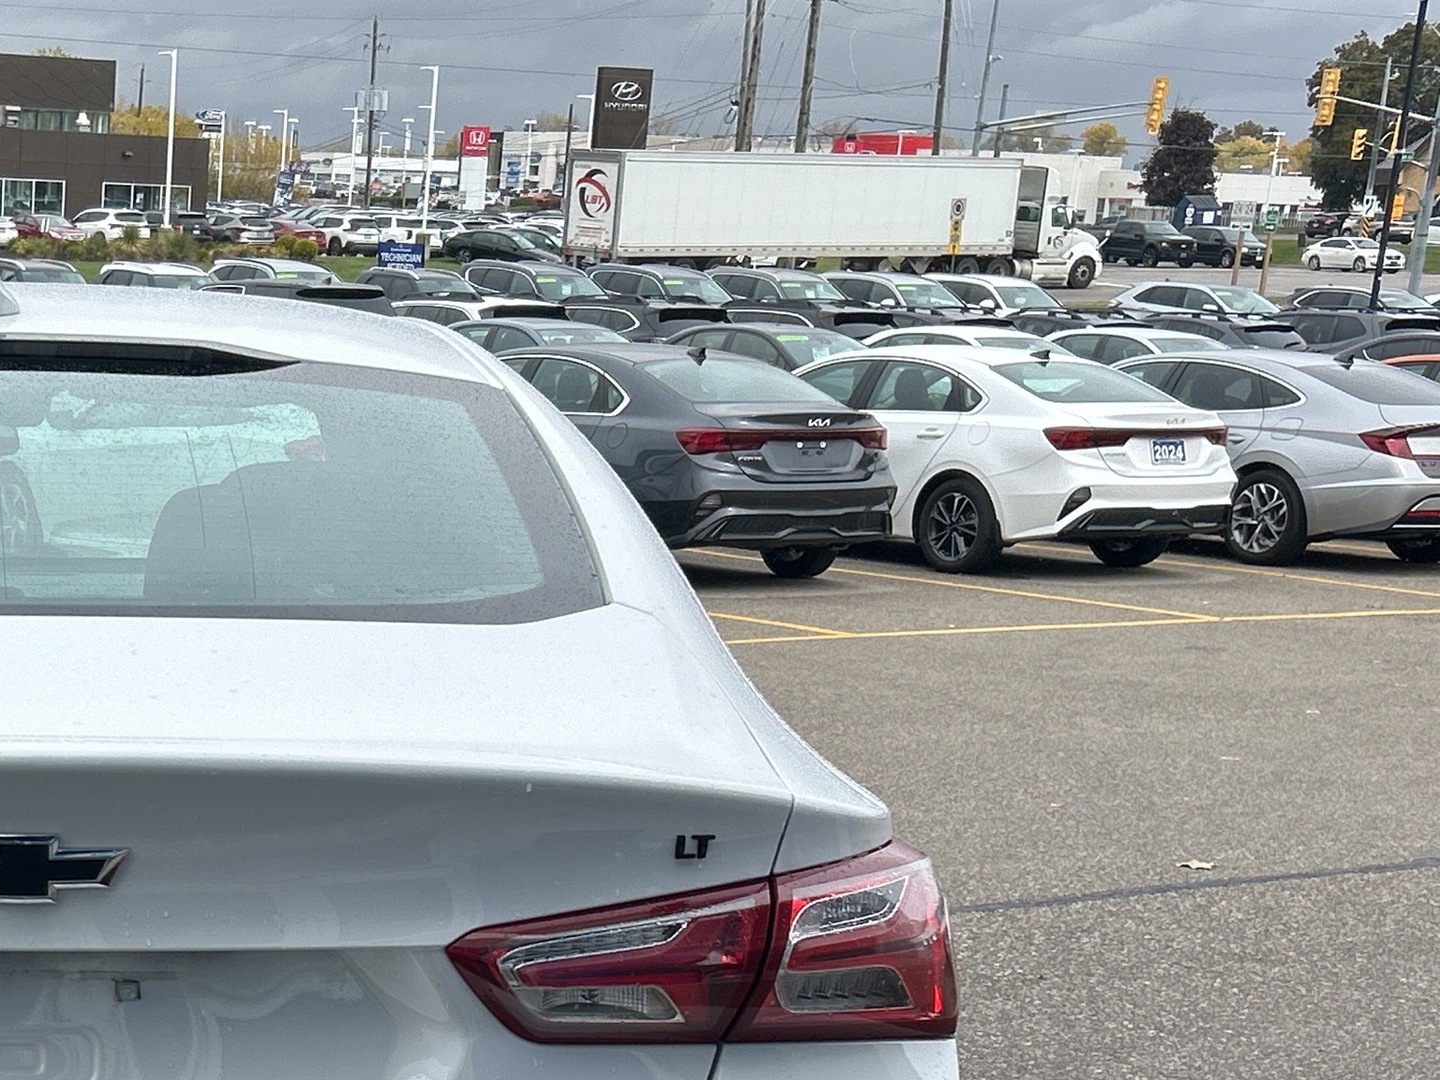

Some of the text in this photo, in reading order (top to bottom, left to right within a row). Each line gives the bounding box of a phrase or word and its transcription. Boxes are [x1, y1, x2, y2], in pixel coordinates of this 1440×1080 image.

[380, 252, 422, 263] TECHNICIAN
[1154, 444, 1184, 460] 2024
[675, 834, 716, 859] LT
